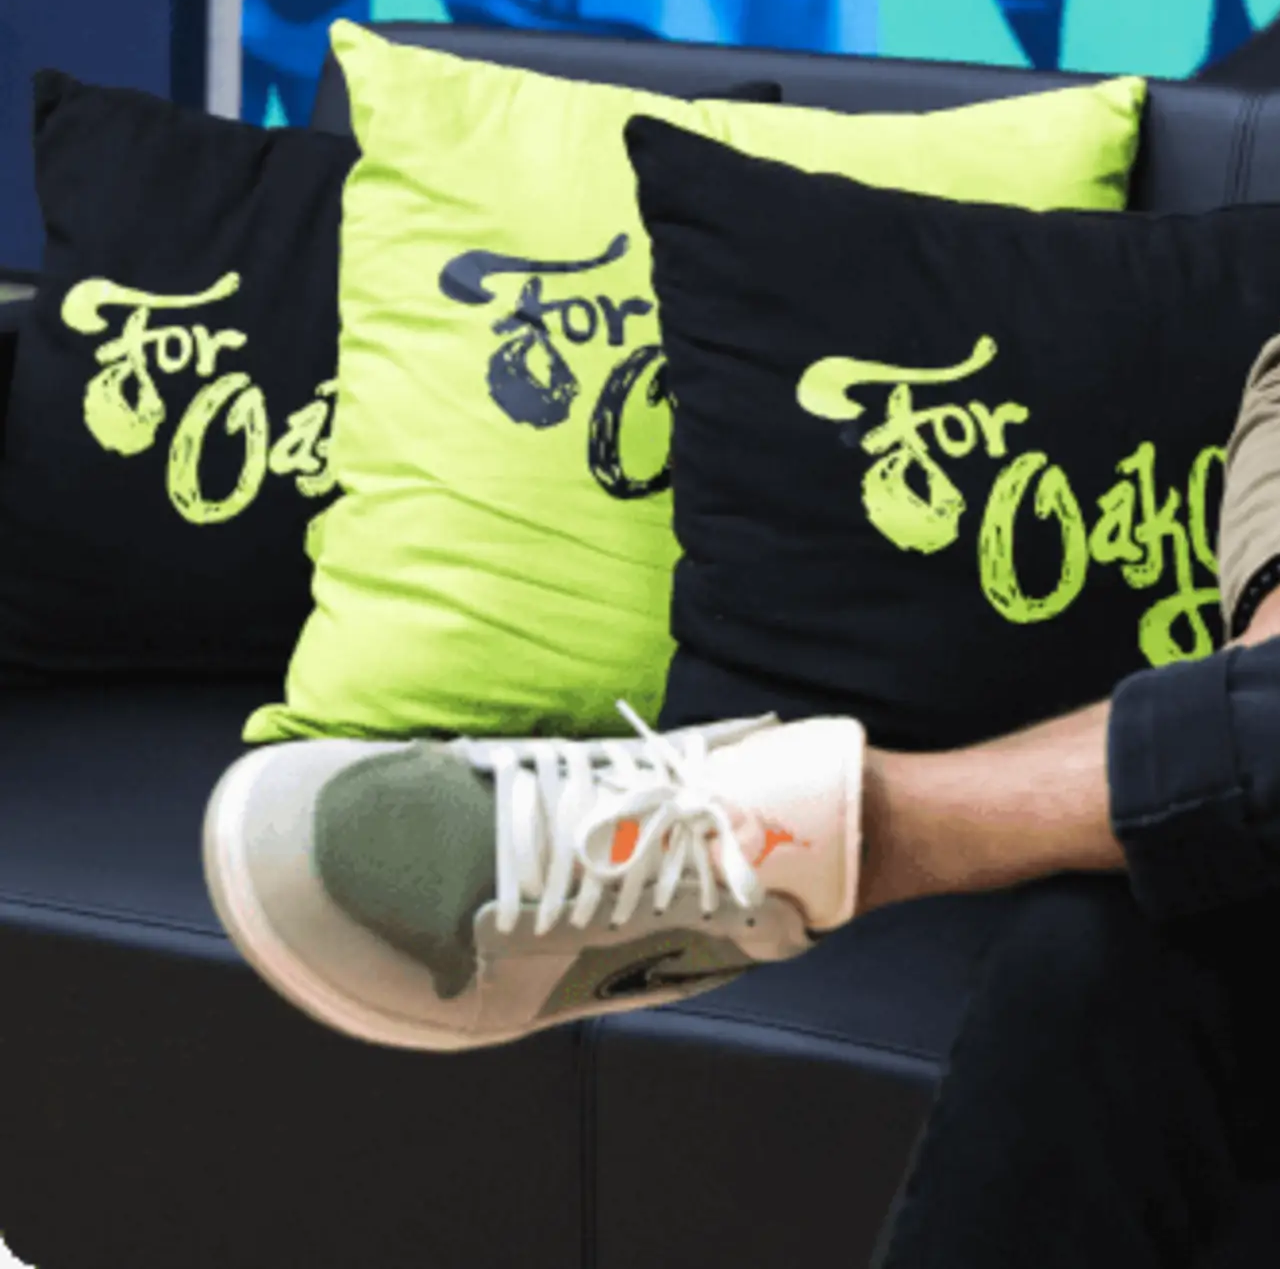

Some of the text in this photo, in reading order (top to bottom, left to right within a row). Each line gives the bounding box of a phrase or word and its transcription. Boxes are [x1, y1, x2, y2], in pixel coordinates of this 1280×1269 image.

[61, 271, 247, 456] For
[440, 233, 652, 429] For
[797, 335, 1029, 554] For
